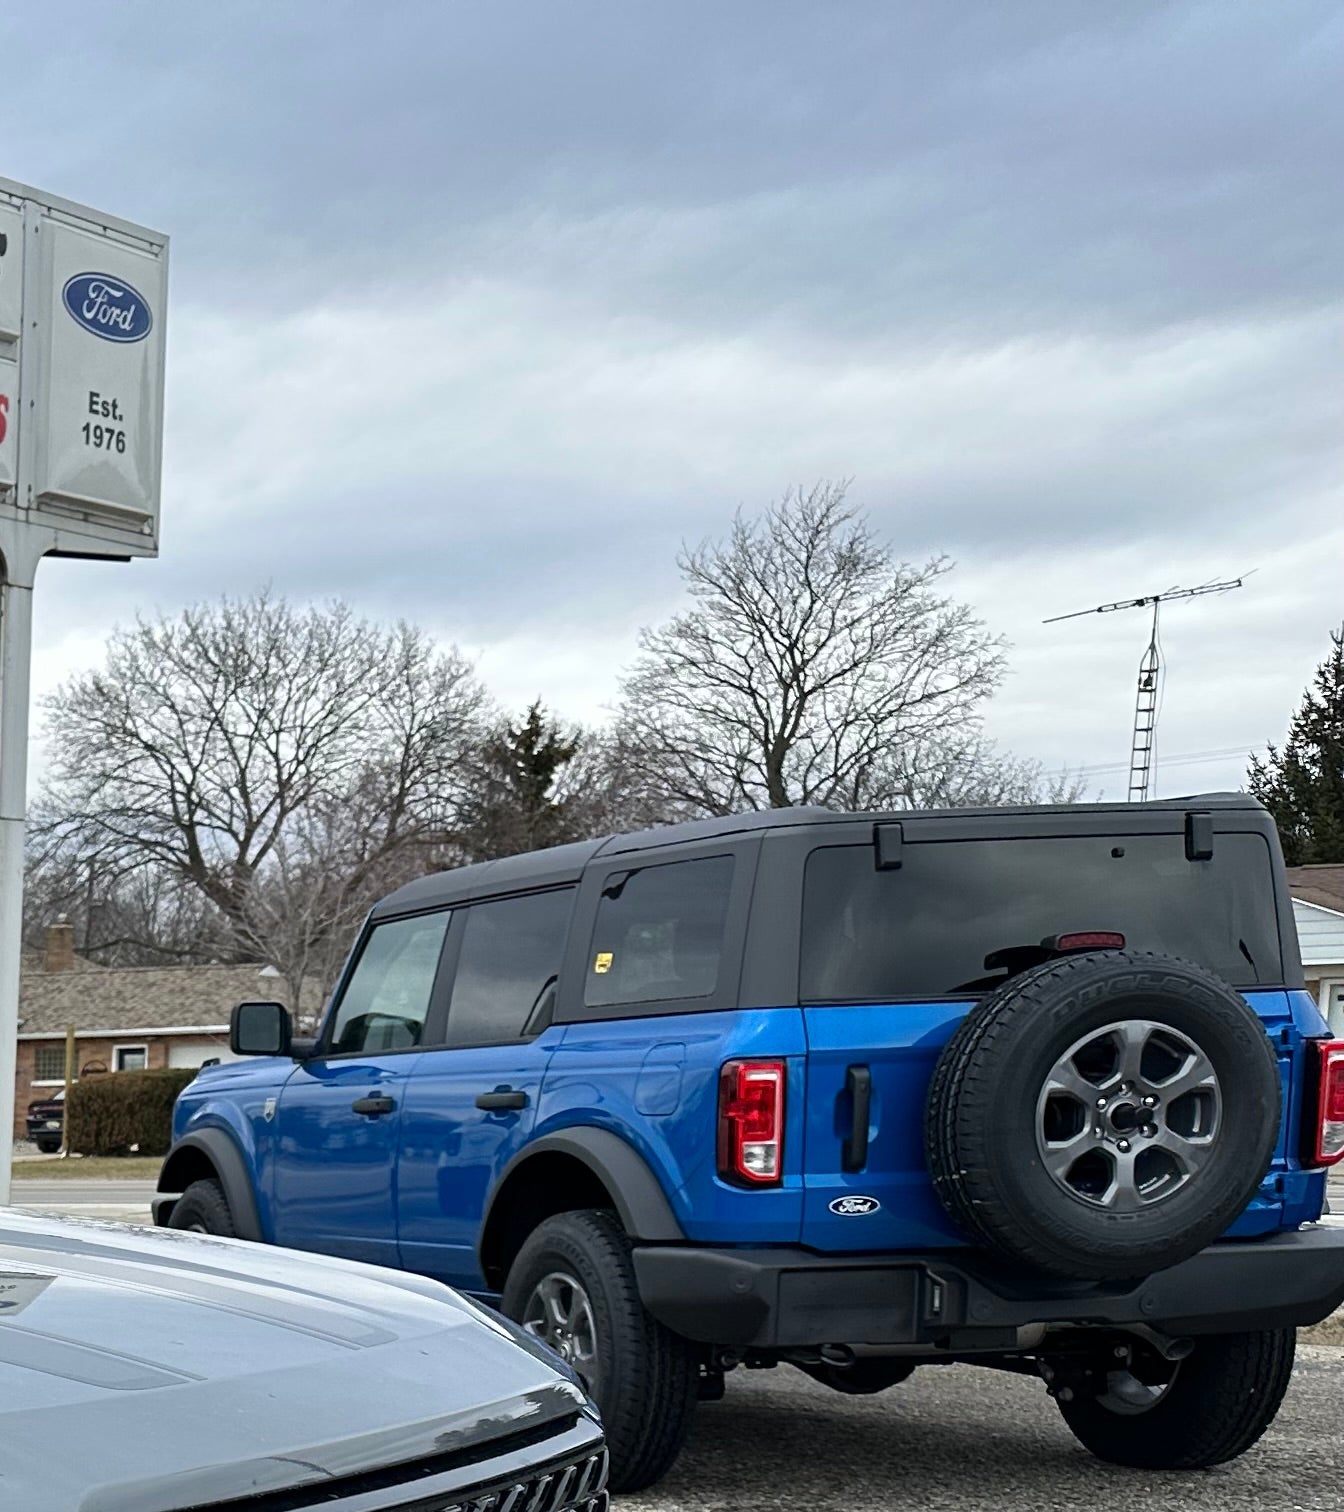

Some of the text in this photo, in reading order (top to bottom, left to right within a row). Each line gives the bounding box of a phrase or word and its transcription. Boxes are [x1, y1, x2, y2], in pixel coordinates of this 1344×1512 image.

[82, 281, 136, 331] Ford
[88, 390, 123, 422] Est.
[82, 422, 126, 454] 1976
